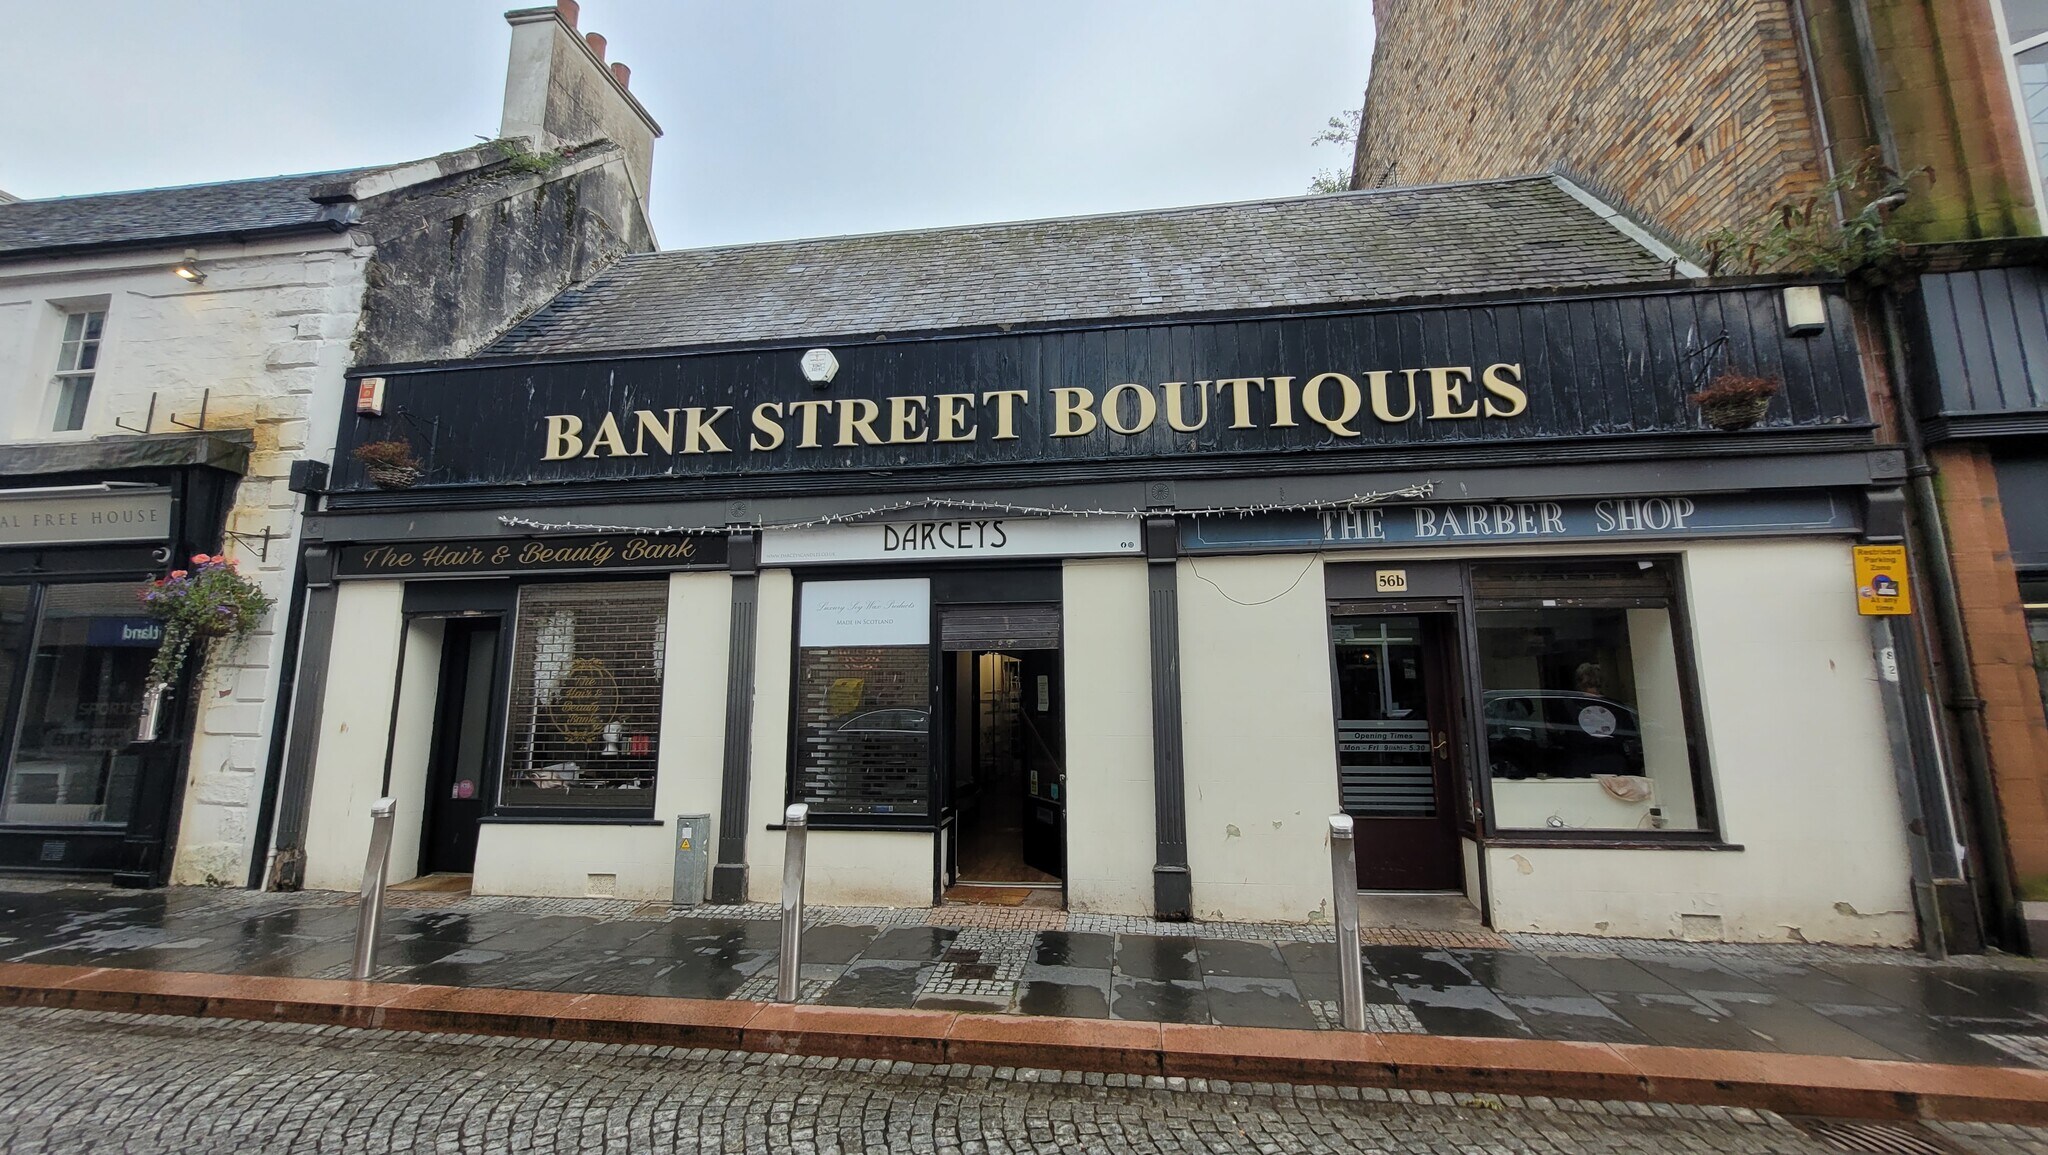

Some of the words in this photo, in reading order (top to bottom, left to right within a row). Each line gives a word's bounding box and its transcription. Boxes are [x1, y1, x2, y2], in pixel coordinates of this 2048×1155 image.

[540, 404, 734, 461] BANK
[750, 389, 1028, 452] STREET
[1049, 363, 1528, 438] BOUTIQUES
[33, 512, 78, 527] FREE
[91, 509, 158, 524] HOUSE
[1317, 508, 1386, 541] THE
[1412, 502, 1567, 538] BARBER
[1594, 498, 1695, 532] SHOP
[883, 520, 1008, 552] DARCEYS
[363, 545, 417, 570] The
[422, 544, 484, 568] Hair
[491, 545, 511, 566] &
[518, 540, 615, 567] Beauty
[622, 537, 696, 561] Bank
[1378, 574, 1405, 589] 56b
[1354, 732, 1387, 740] Opening
